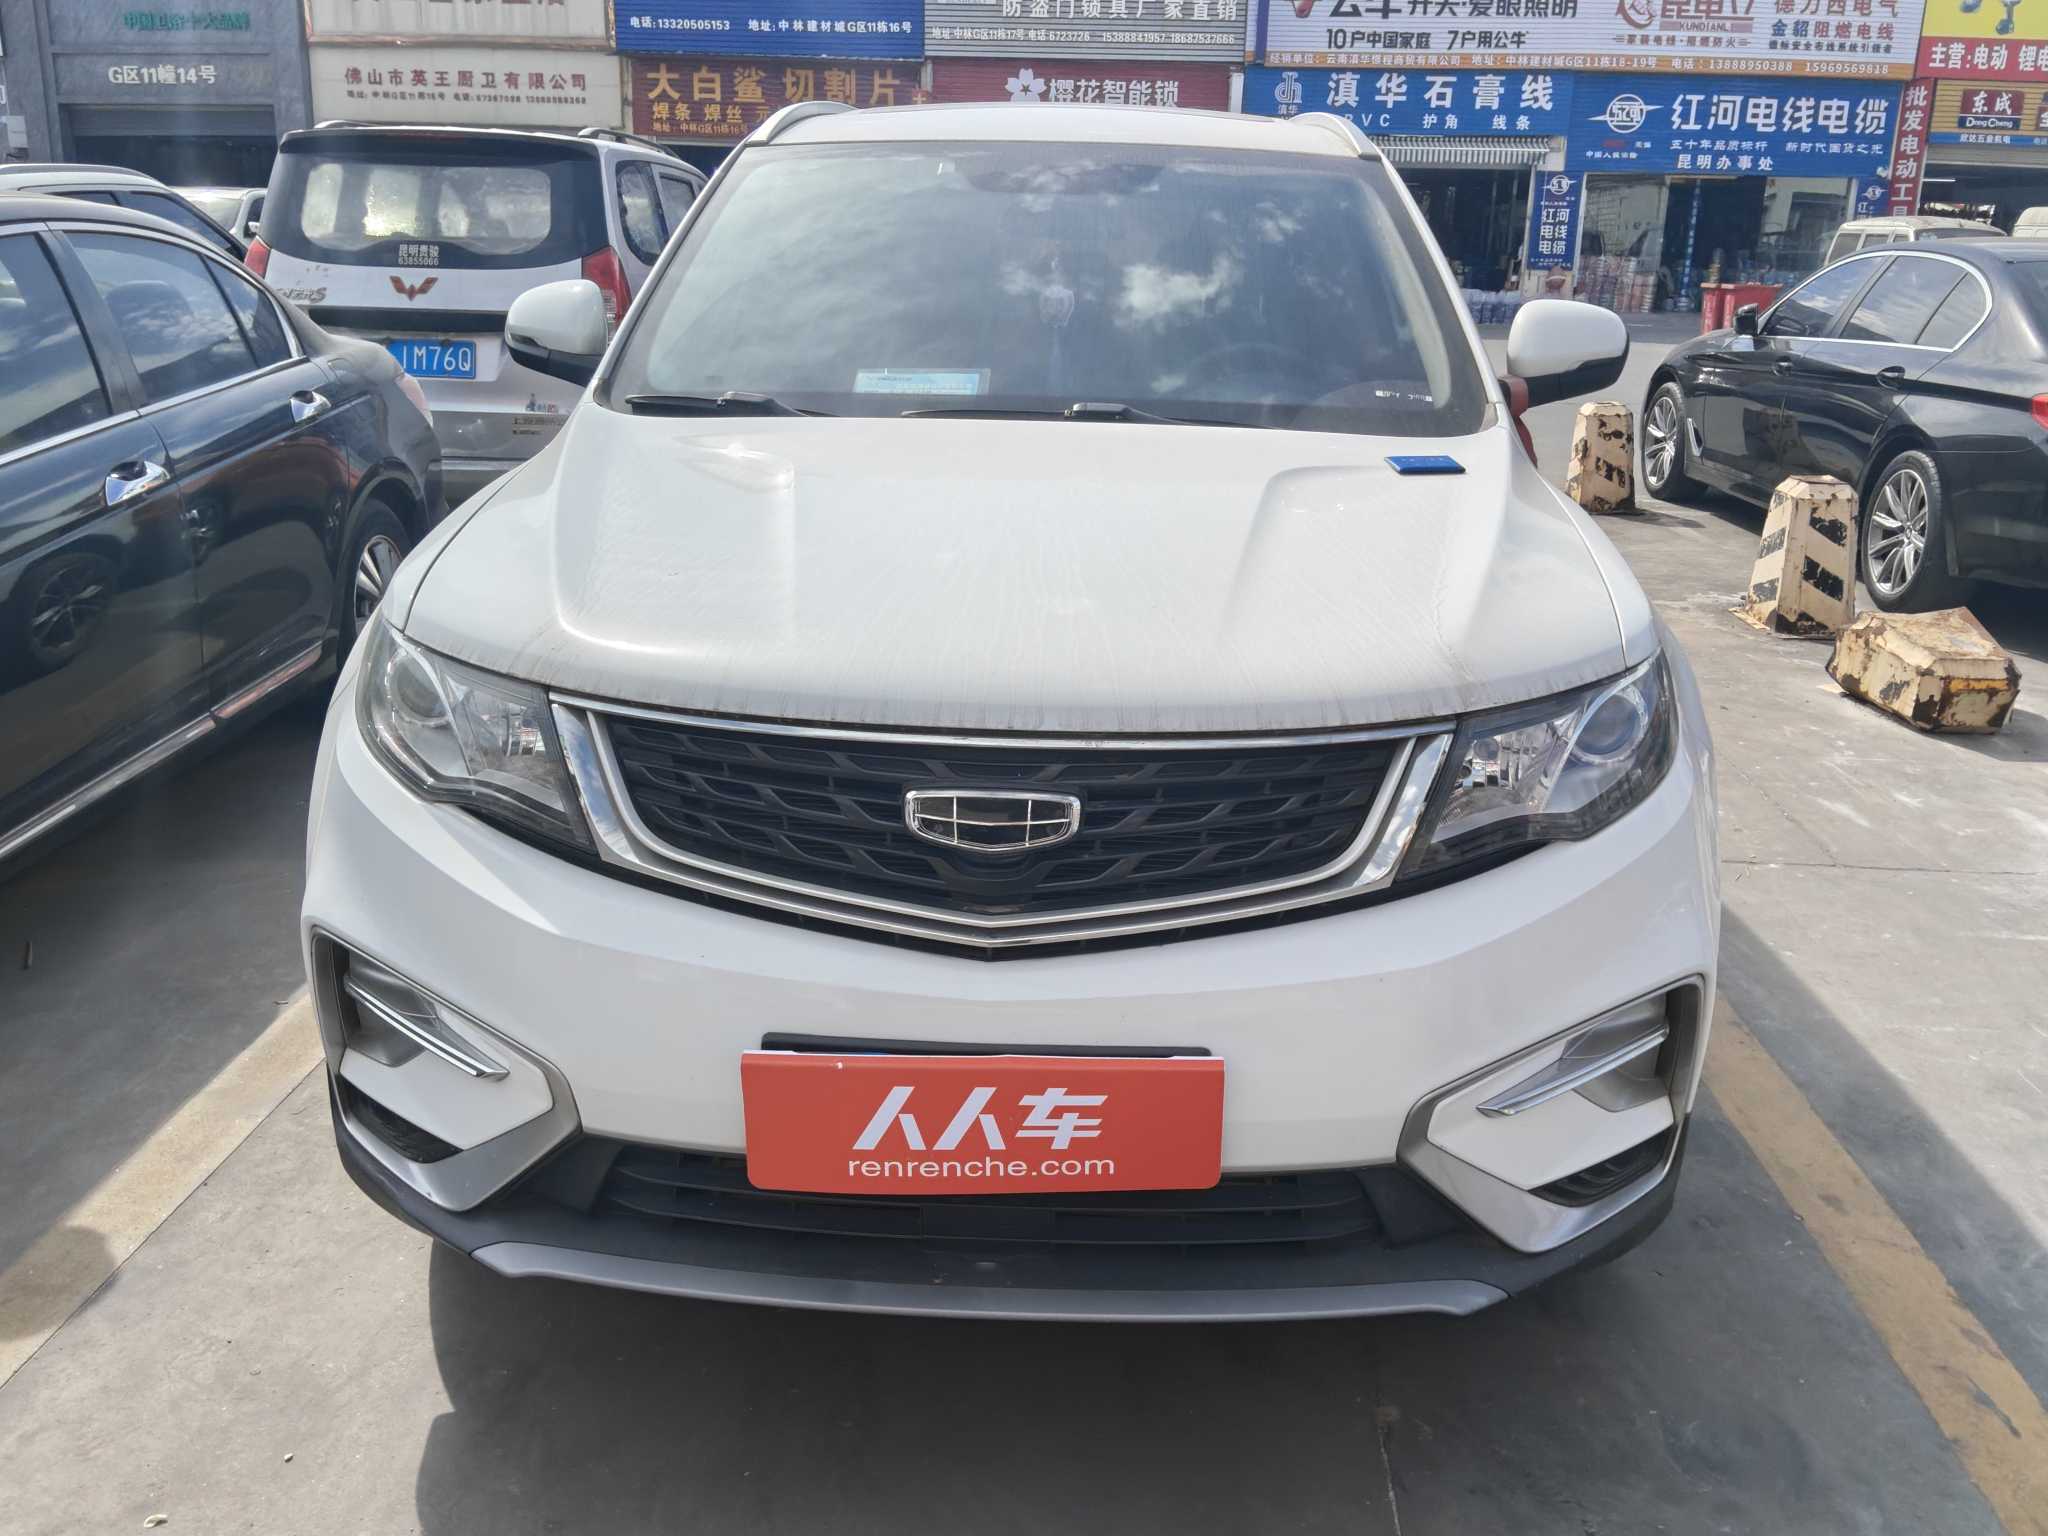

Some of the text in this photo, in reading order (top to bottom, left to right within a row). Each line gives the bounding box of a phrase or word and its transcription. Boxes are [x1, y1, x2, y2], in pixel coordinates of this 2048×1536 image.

[1326, 28, 1431, 49] 10户中国家庭
[344, 66, 587, 91] 佛山市英王厨卫有限公司
[783, 67, 900, 105] 切割片
[1326, 71, 1554, 111] 滇华石膏线
[1049, 79, 1179, 107] 樱花智能锁
[1972, 90, 2013, 115] 东成
[1423, 113, 1459, 129] 护角
[1492, 114, 1531, 131] 线条
[1671, 94, 1890, 135] 红河电线电缆
[1677, 154, 1774, 171] 昆明办事处
[852, 1085, 1108, 1151] 人人车
[848, 1156, 1115, 1178] renrenche.com
